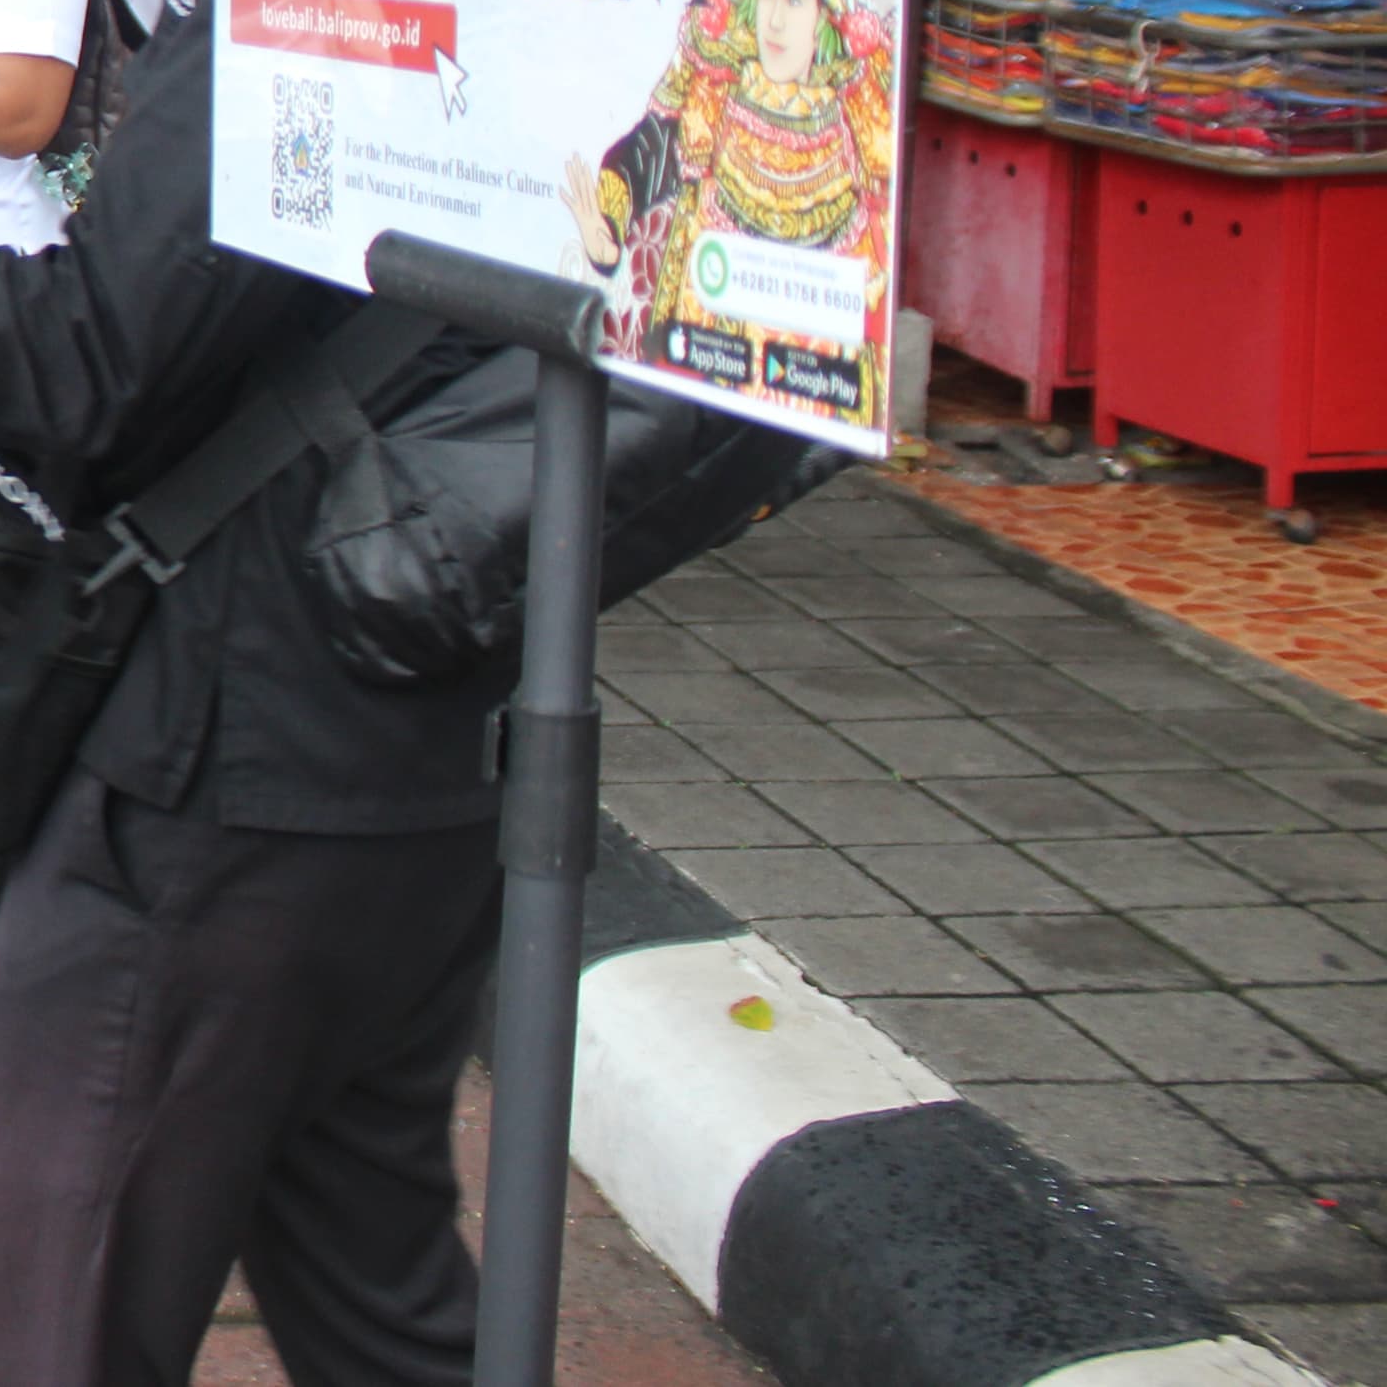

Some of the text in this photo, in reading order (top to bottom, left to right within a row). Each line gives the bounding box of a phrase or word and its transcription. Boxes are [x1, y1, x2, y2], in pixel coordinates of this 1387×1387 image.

[261, 1, 421, 47] lovebali.baliprov.go.id
[345, 136, 555, 200] For the Protection of Balinese Culture
[345, 172, 482, 218] and Natural Environment
[689, 343, 747, 377] App Store
[787, 362, 858, 407] Google Play
